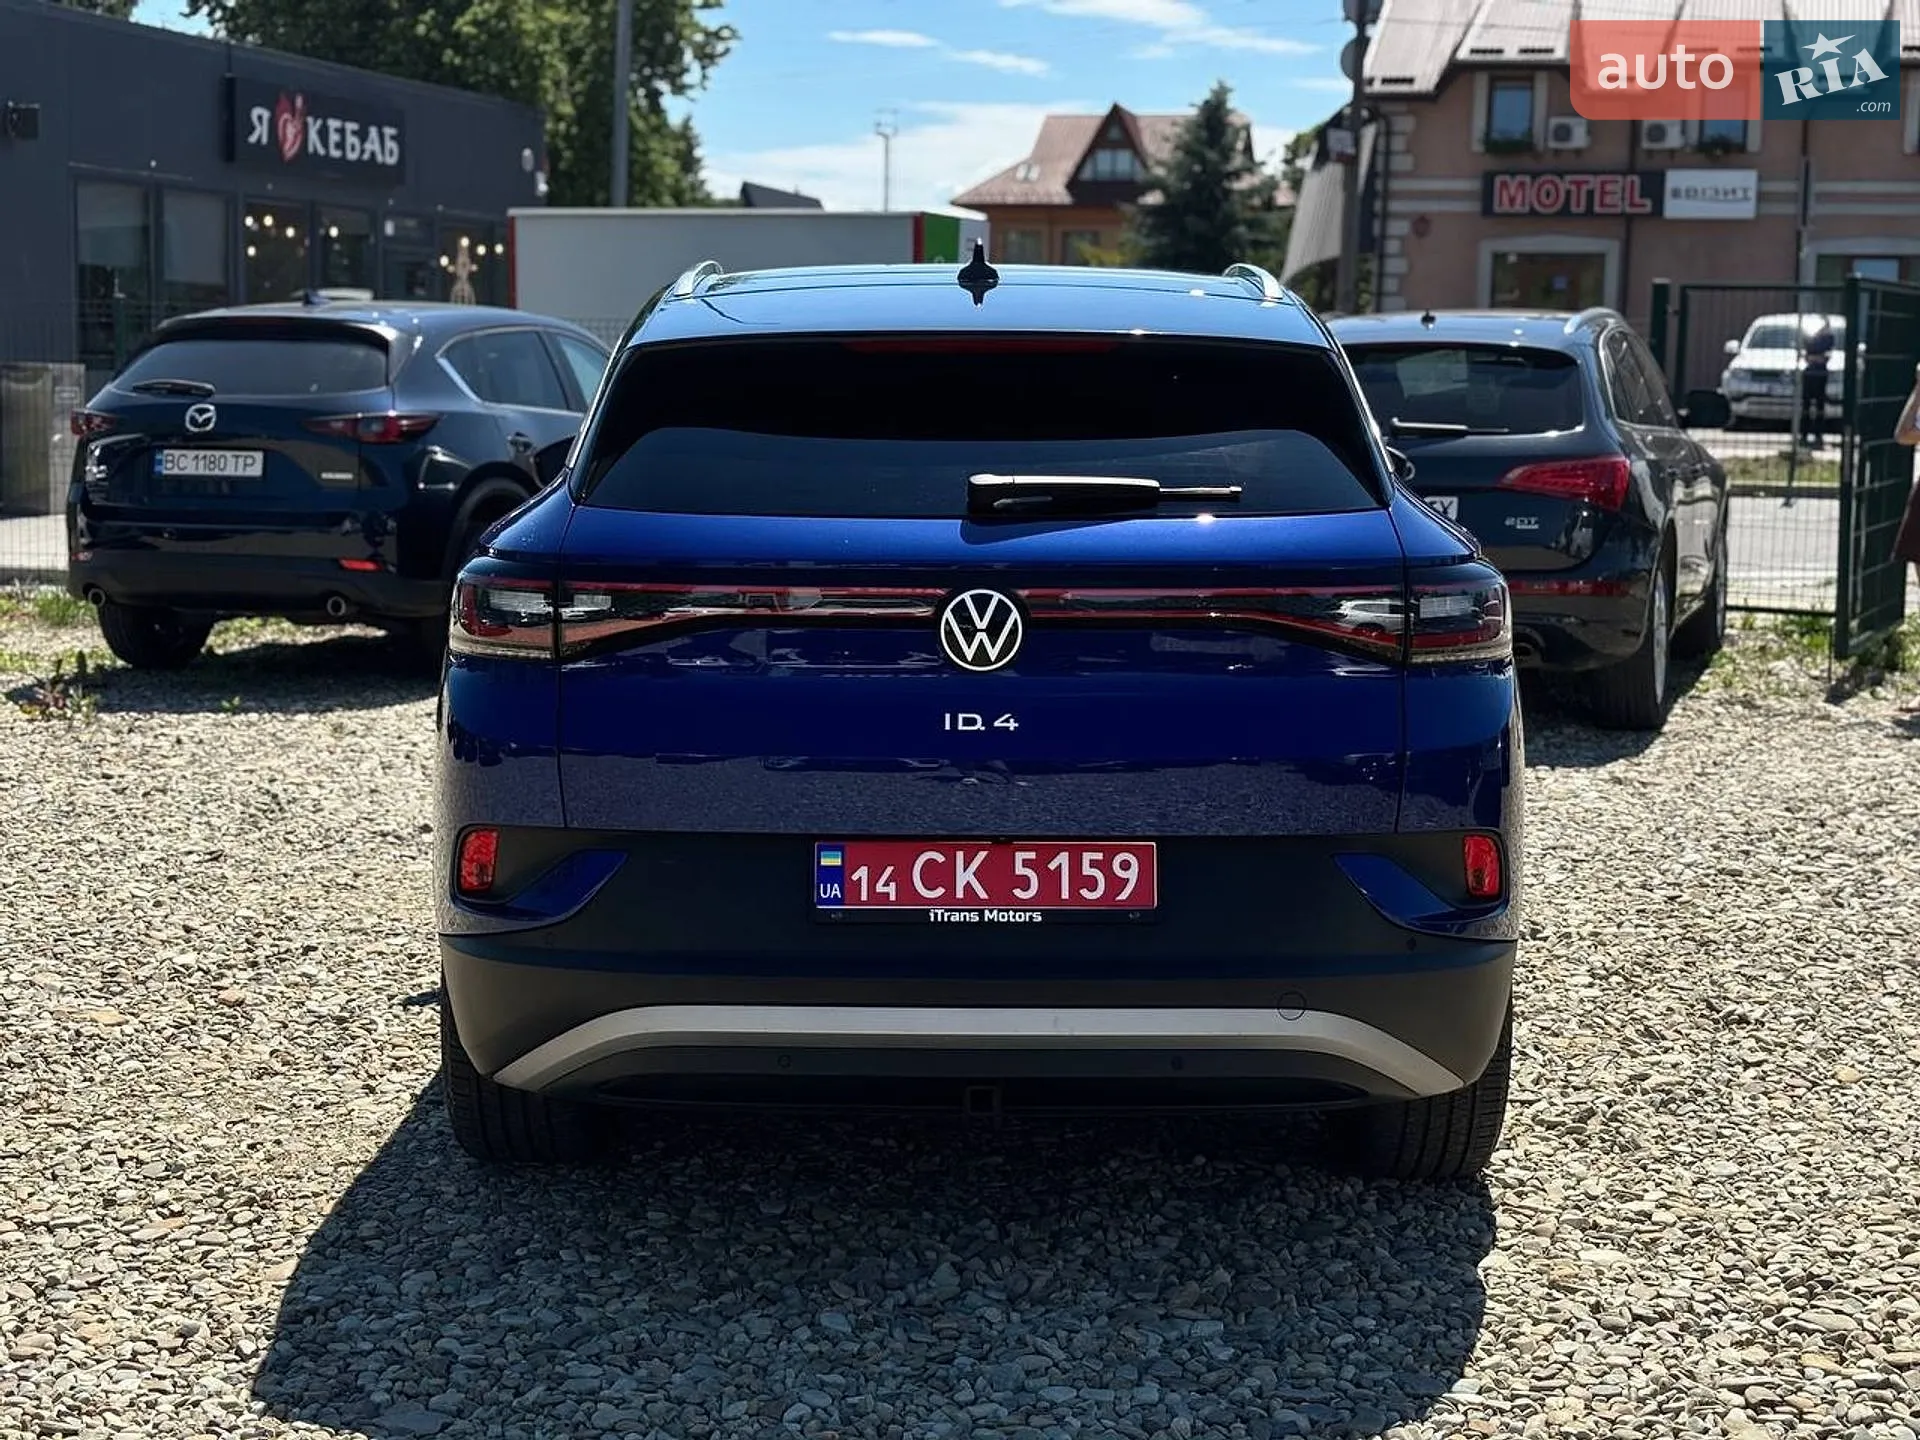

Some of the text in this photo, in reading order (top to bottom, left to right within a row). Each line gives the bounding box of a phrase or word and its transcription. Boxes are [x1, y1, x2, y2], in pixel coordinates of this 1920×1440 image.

[247, 105, 400, 166] Я КЕБАБ
[1492, 173, 1653, 215] MOTEL
[164, 453, 188, 472] BC
[191, 453, 228, 473] 1180
[231, 454, 257, 473] TP
[820, 850, 1140, 901] UA 14 CK 5159
[929, 909, 1042, 923] iTrans Motors
